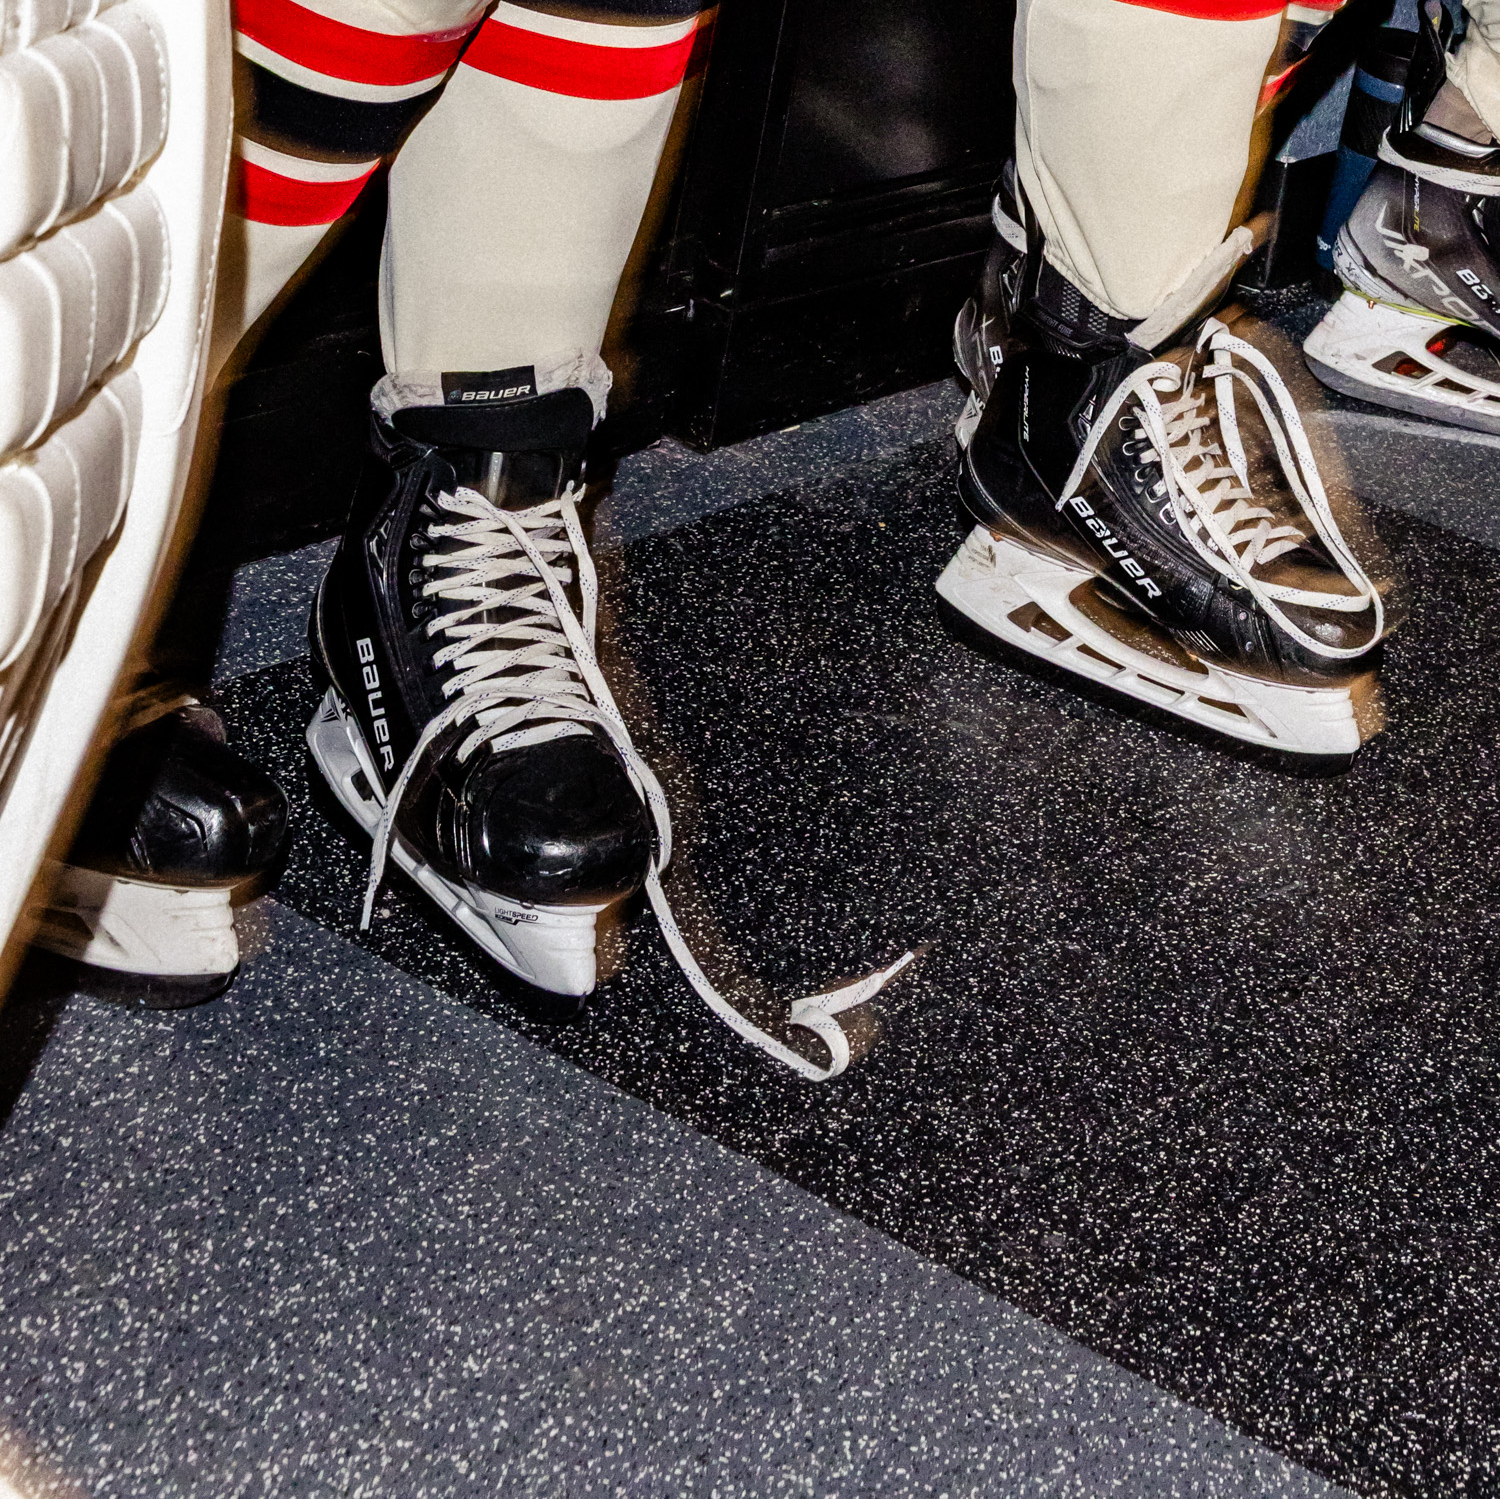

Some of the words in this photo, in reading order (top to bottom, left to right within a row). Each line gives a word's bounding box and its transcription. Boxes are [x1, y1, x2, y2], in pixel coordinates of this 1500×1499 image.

[461, 384, 531, 402] BAUER
[1068, 495, 1163, 601] BAUER
[355, 636, 396, 773] BAUER
[494, 906, 540, 922] LIGHTSPEED
